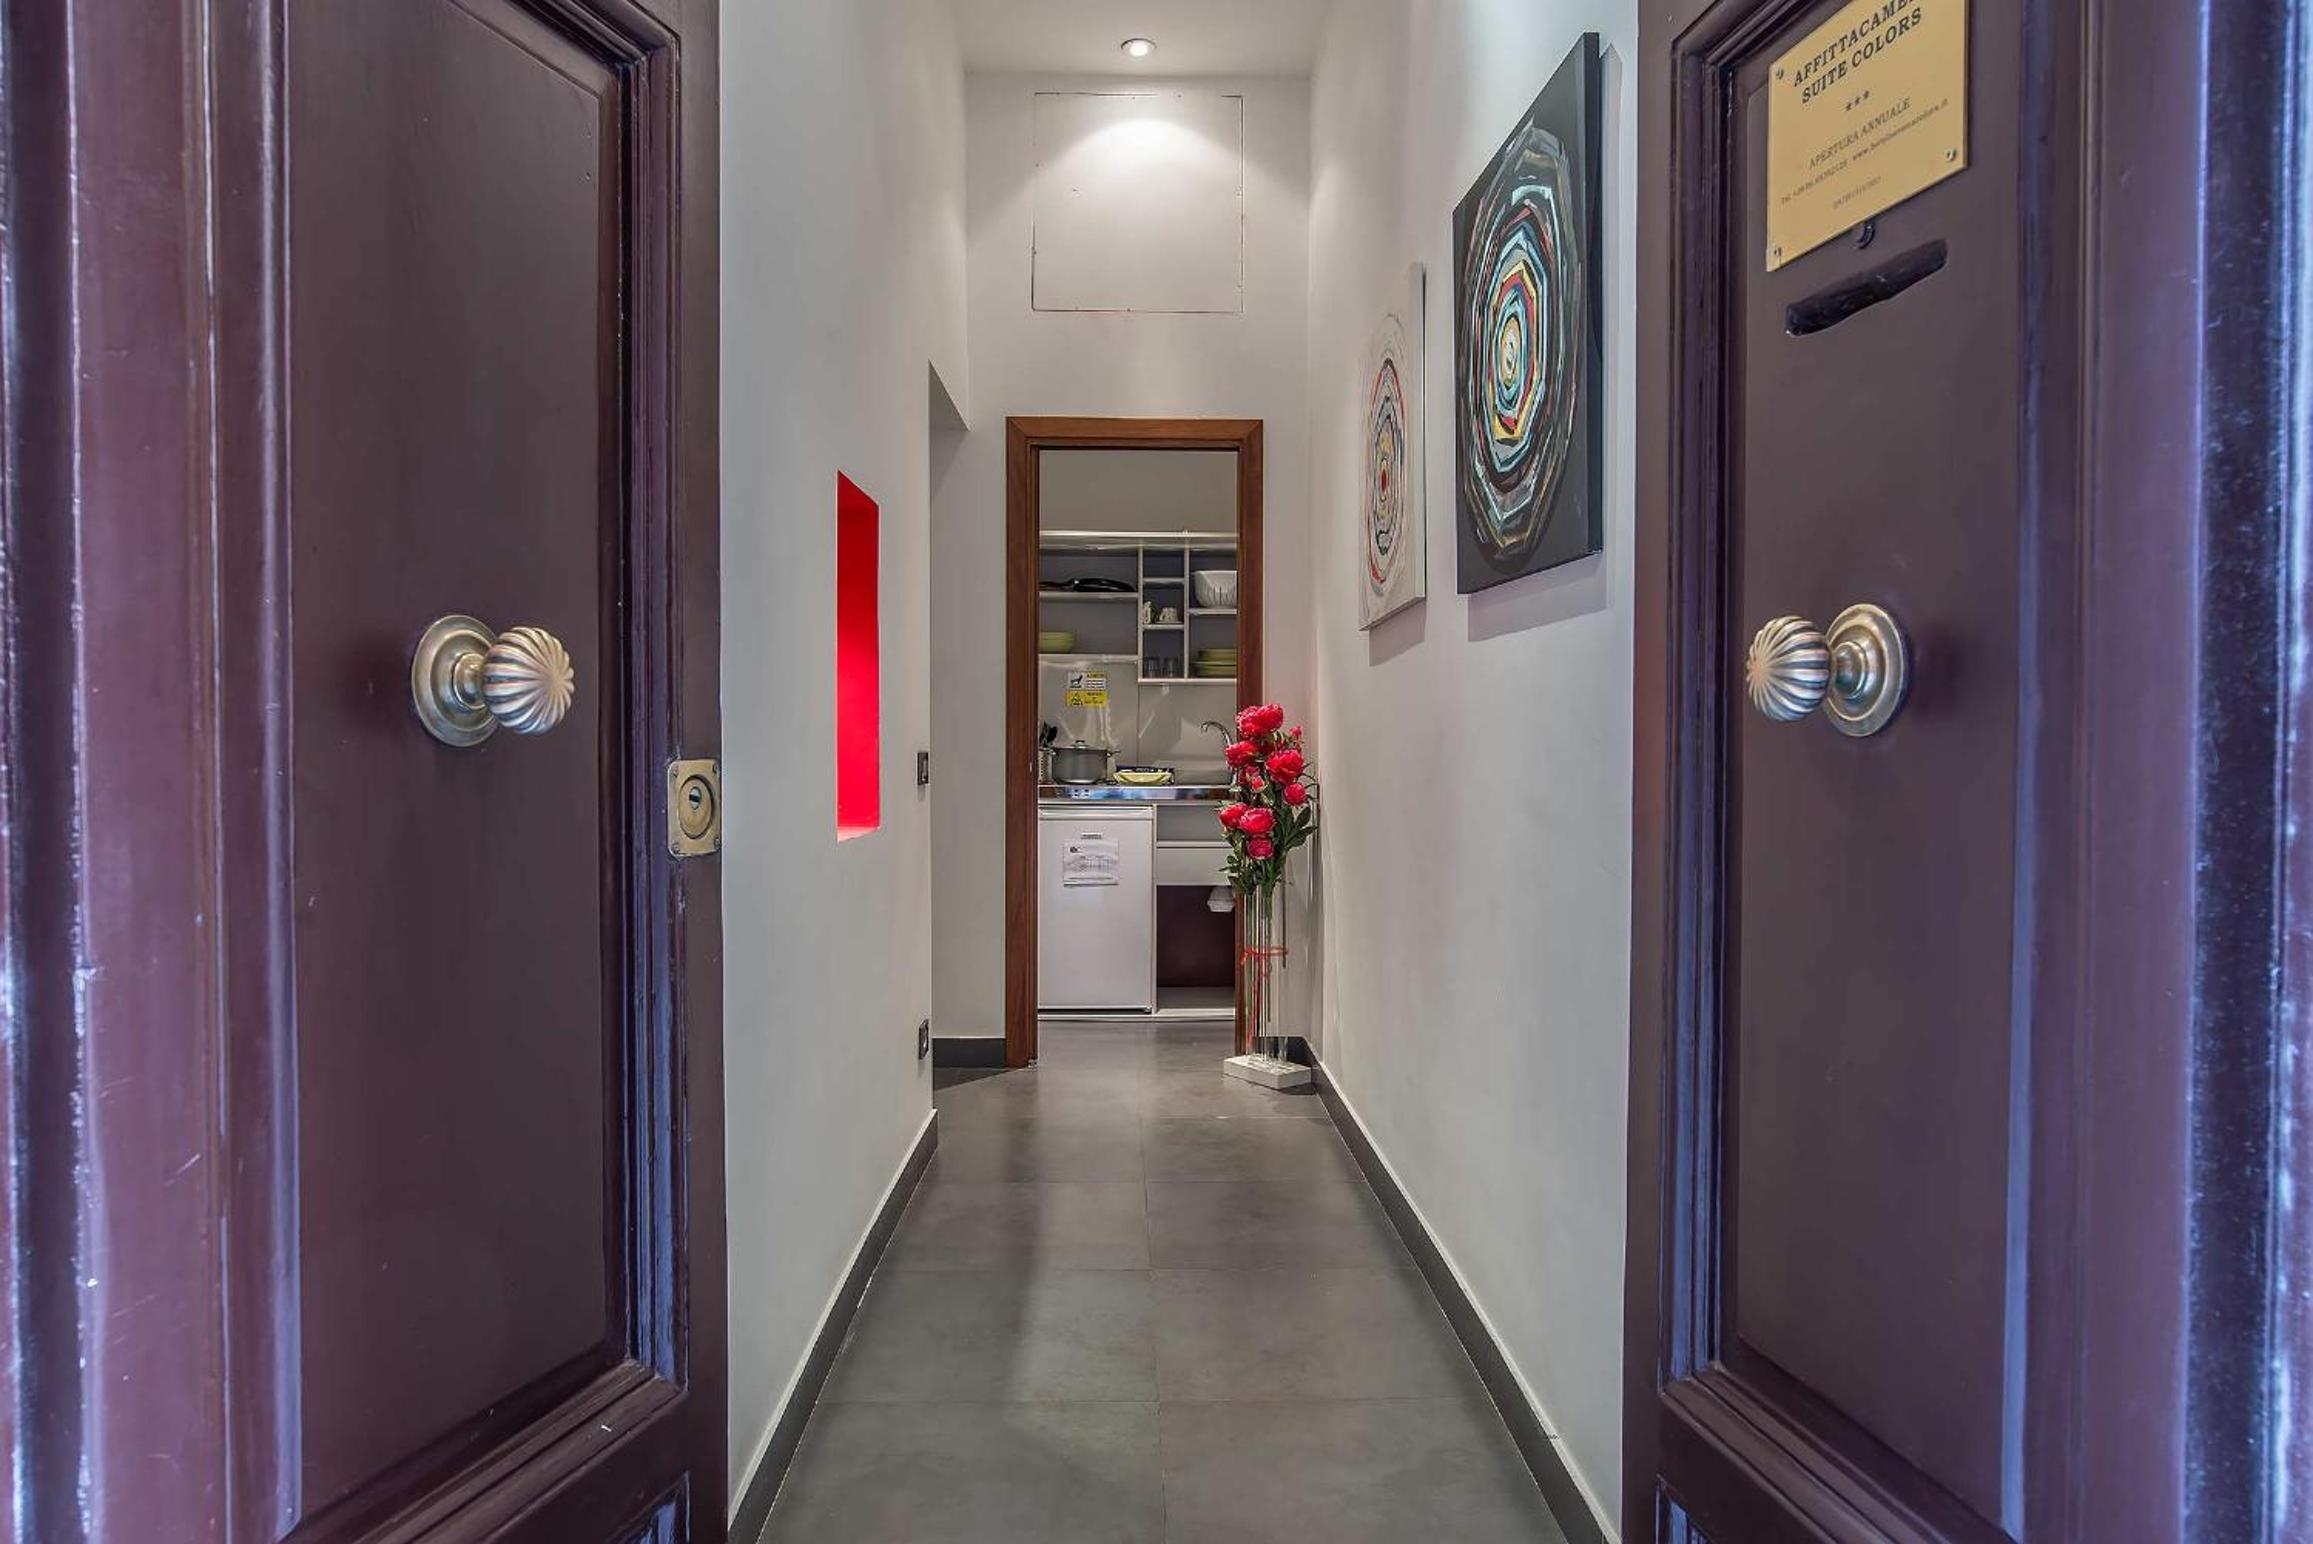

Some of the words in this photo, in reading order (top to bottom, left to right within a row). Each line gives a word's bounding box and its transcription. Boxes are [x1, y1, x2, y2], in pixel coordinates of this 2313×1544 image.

[1794, 0, 1914, 87] AFFITTACAME
[1802, 61, 1848, 104] SUITE
[1851, 7, 1921, 68] COLORS
[1809, 131, 1858, 169] APERTURA
[1860, 96, 1911, 136] ANNUALE
